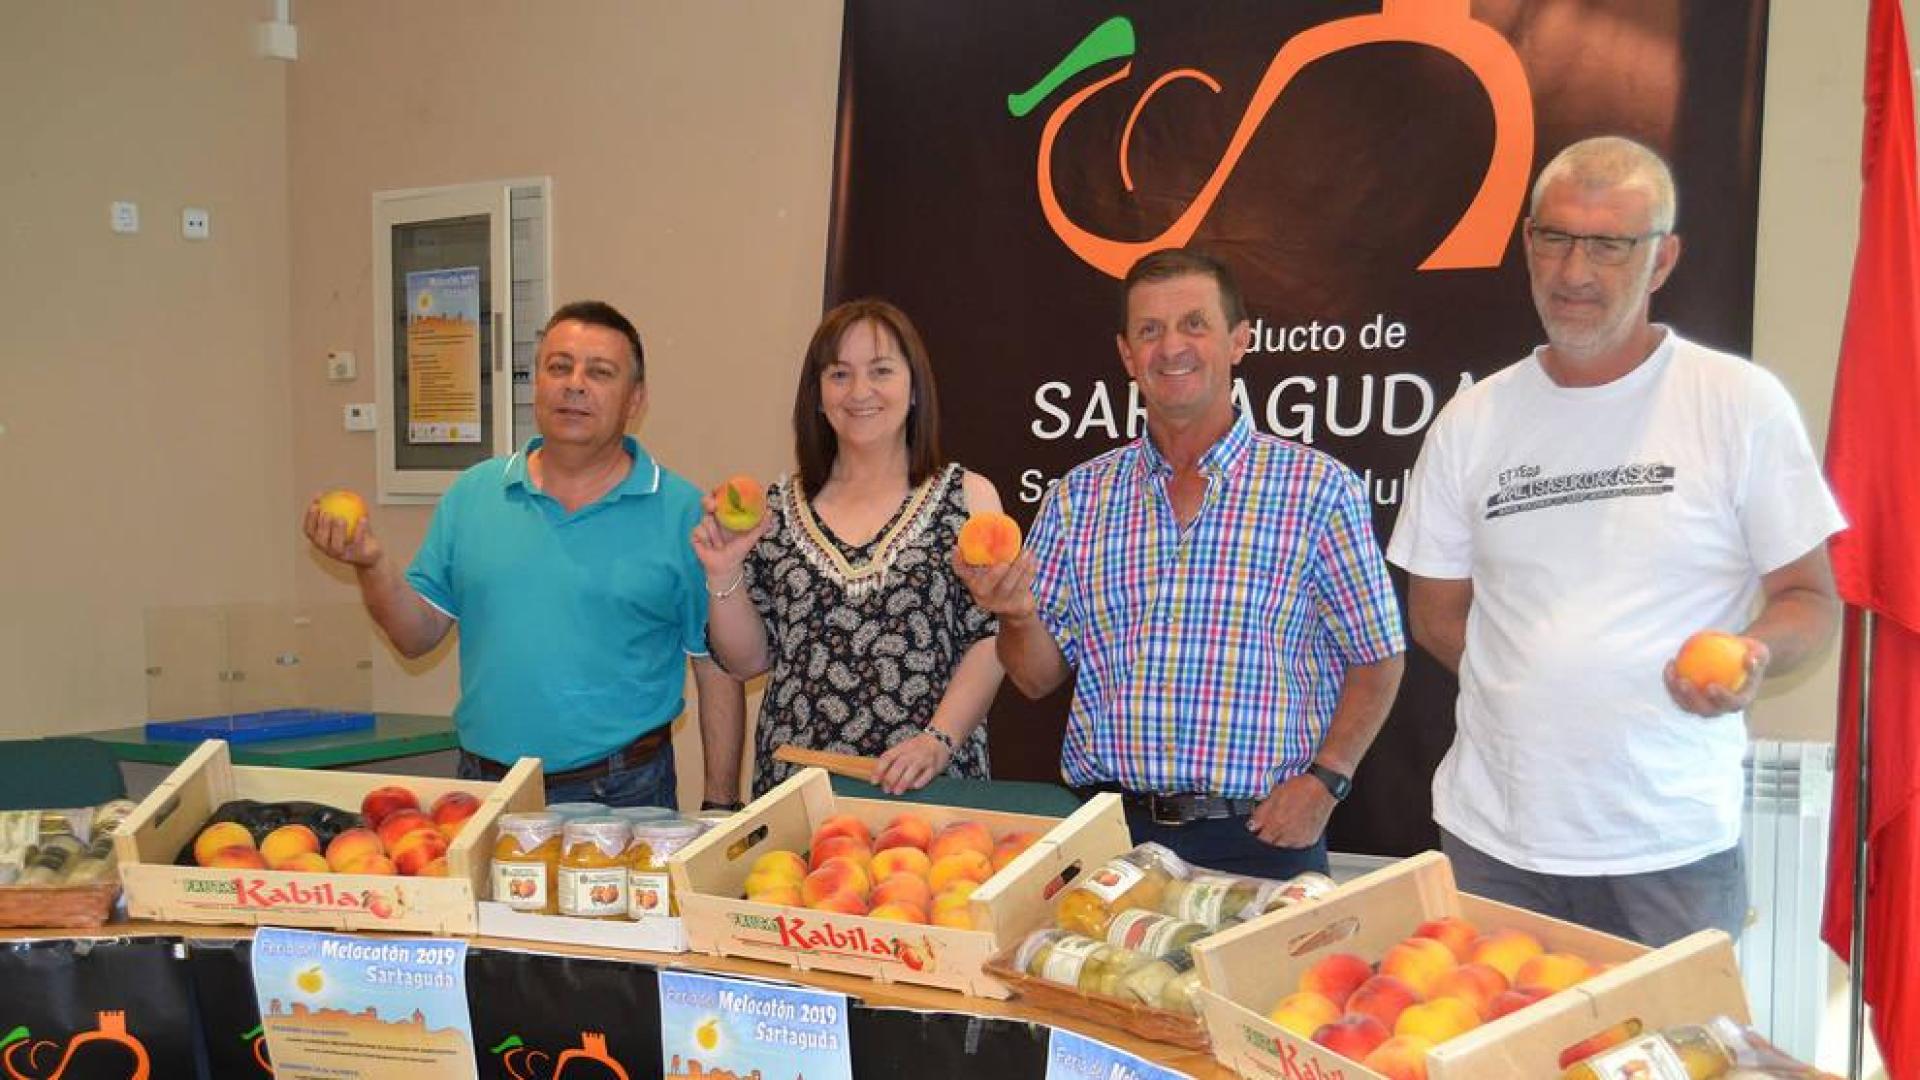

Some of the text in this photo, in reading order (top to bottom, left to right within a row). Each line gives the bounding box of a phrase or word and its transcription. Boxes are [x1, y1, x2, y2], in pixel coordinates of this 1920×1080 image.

[1245, 313, 1407, 353] ducto de
[236, 876, 359, 907] Kabila
[776, 915, 893, 954] Kabila
[321, 940, 409, 963] Melocotón
[416, 947, 456, 965] 2019
[366, 965, 454, 989] Sartaguda
[718, 990, 795, 1019] Melocotón
[800, 1003, 837, 1025] 2019
[755, 1021, 838, 1050] Sartaguda
